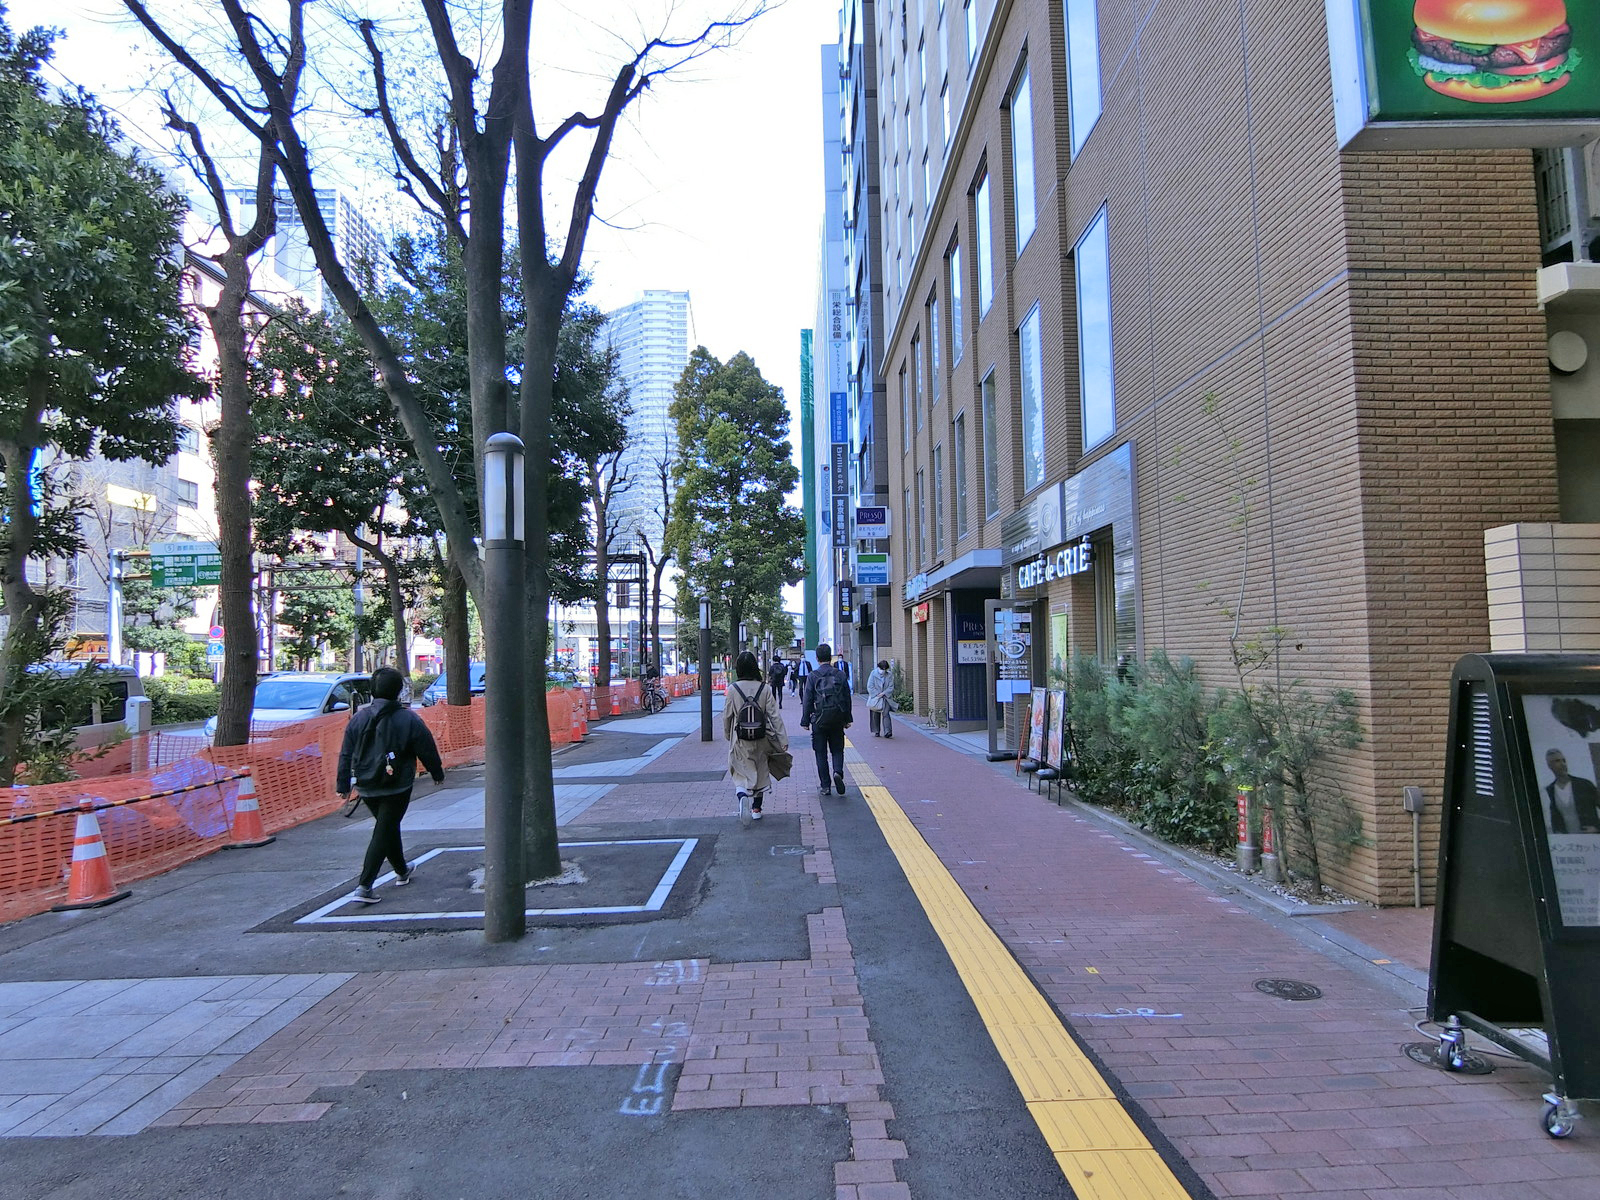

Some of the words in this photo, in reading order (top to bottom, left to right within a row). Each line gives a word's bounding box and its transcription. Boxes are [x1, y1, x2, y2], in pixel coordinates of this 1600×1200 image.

[1018, 553, 1046, 589] CAFÉ
[1045, 555, 1055, 582] de
[1056, 534, 1093, 578] CRIÉ
[962, 620, 985, 633] PRES
[211, 645, 219, 655] P
